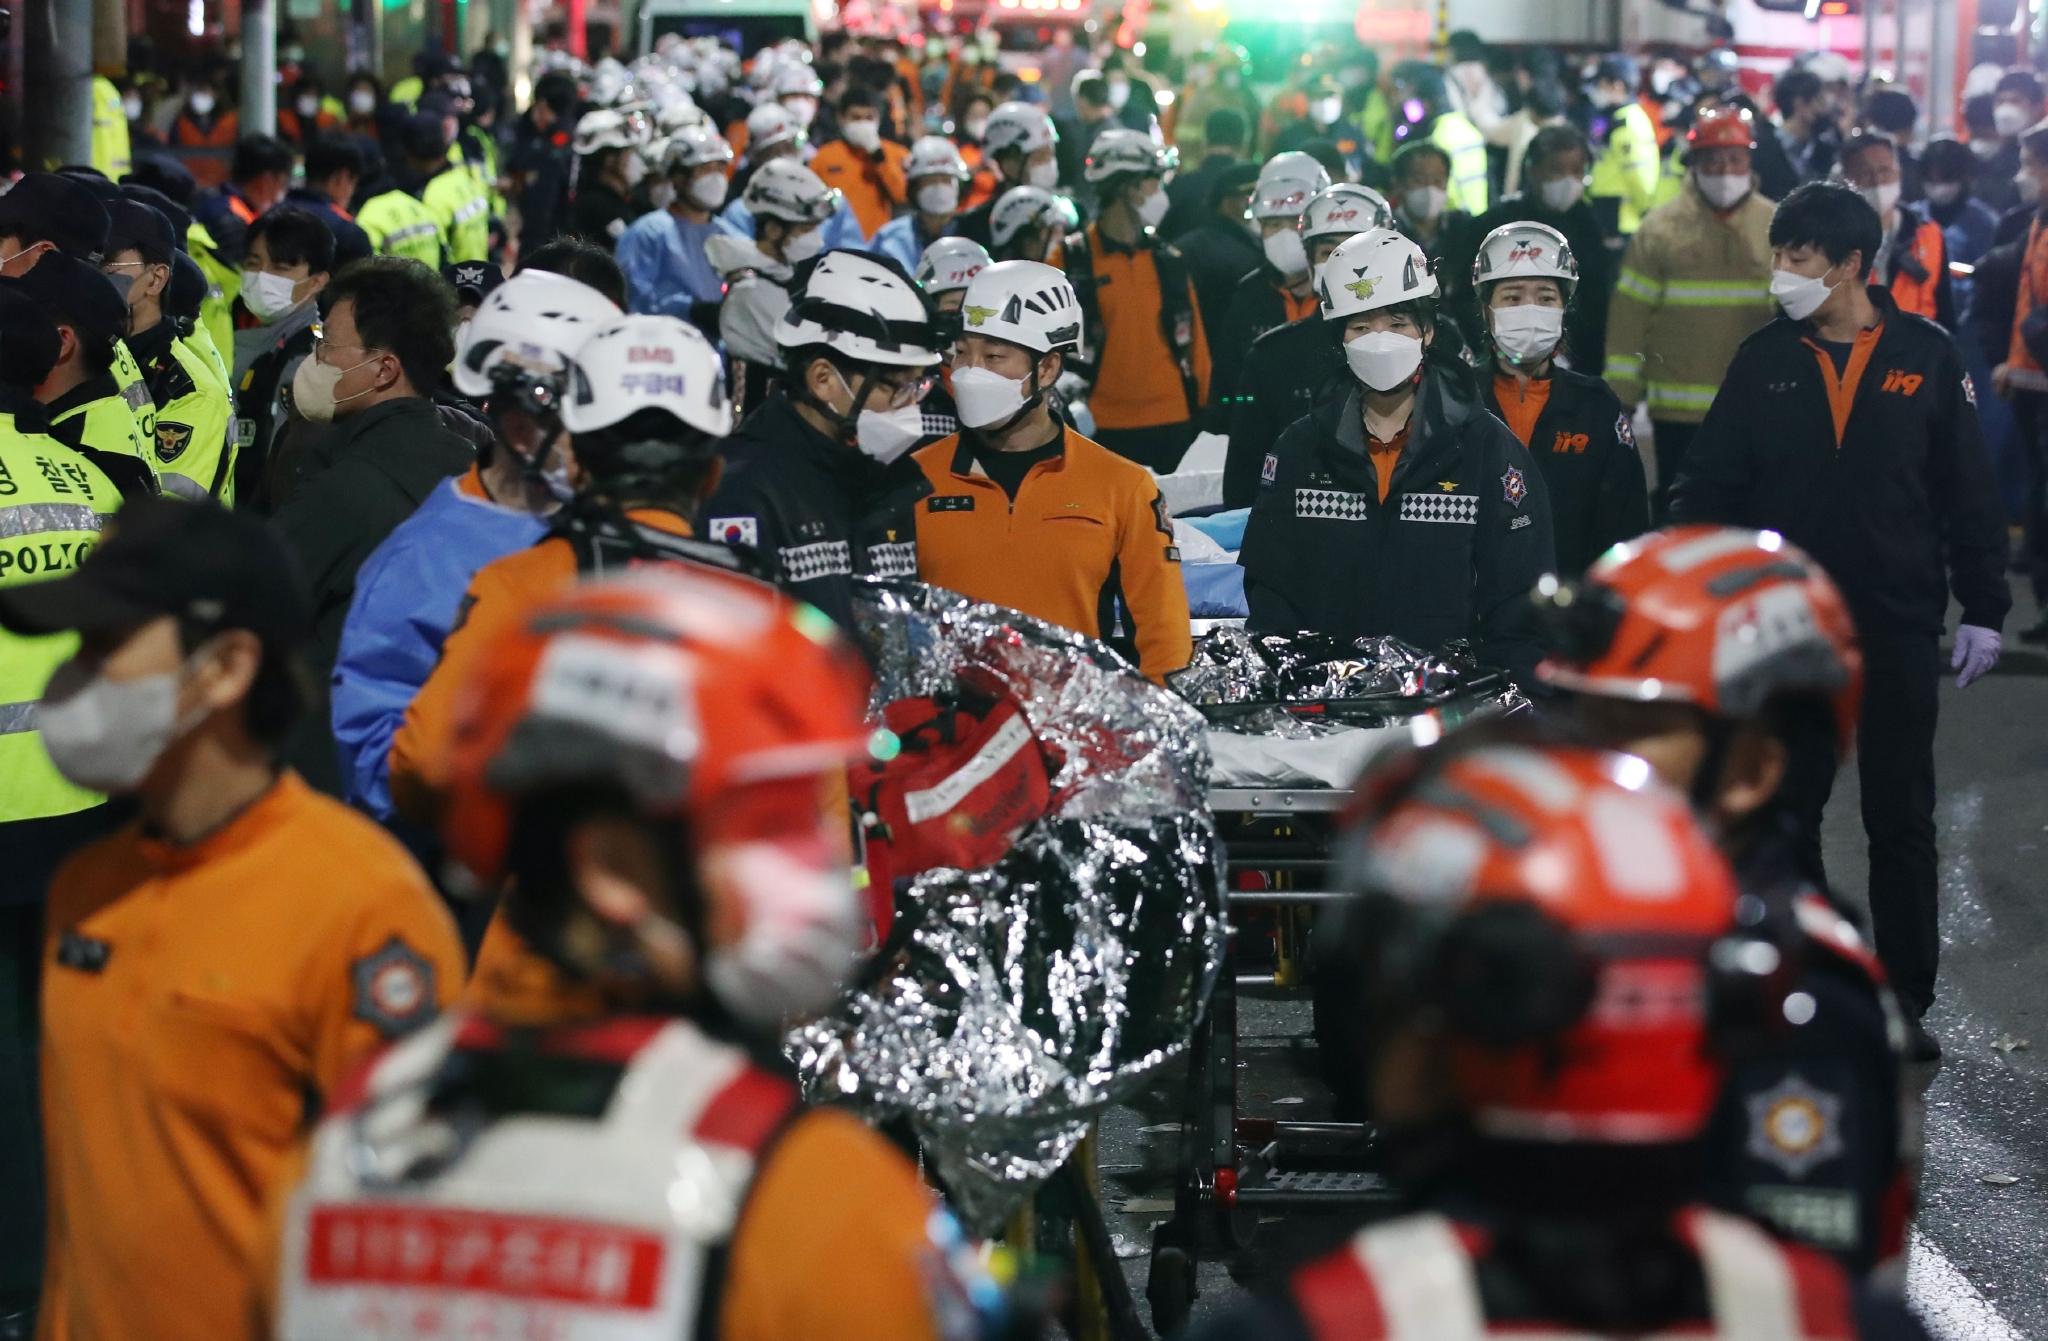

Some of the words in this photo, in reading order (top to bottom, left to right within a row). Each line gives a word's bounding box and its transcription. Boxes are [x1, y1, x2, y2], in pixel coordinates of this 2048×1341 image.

[1509, 247, 1543, 261] 119
[628, 346, 674, 364] EMS
[621, 373, 684, 396] 구급대
[1881, 374, 1923, 396] 119
[1552, 433, 1590, 453] 119
